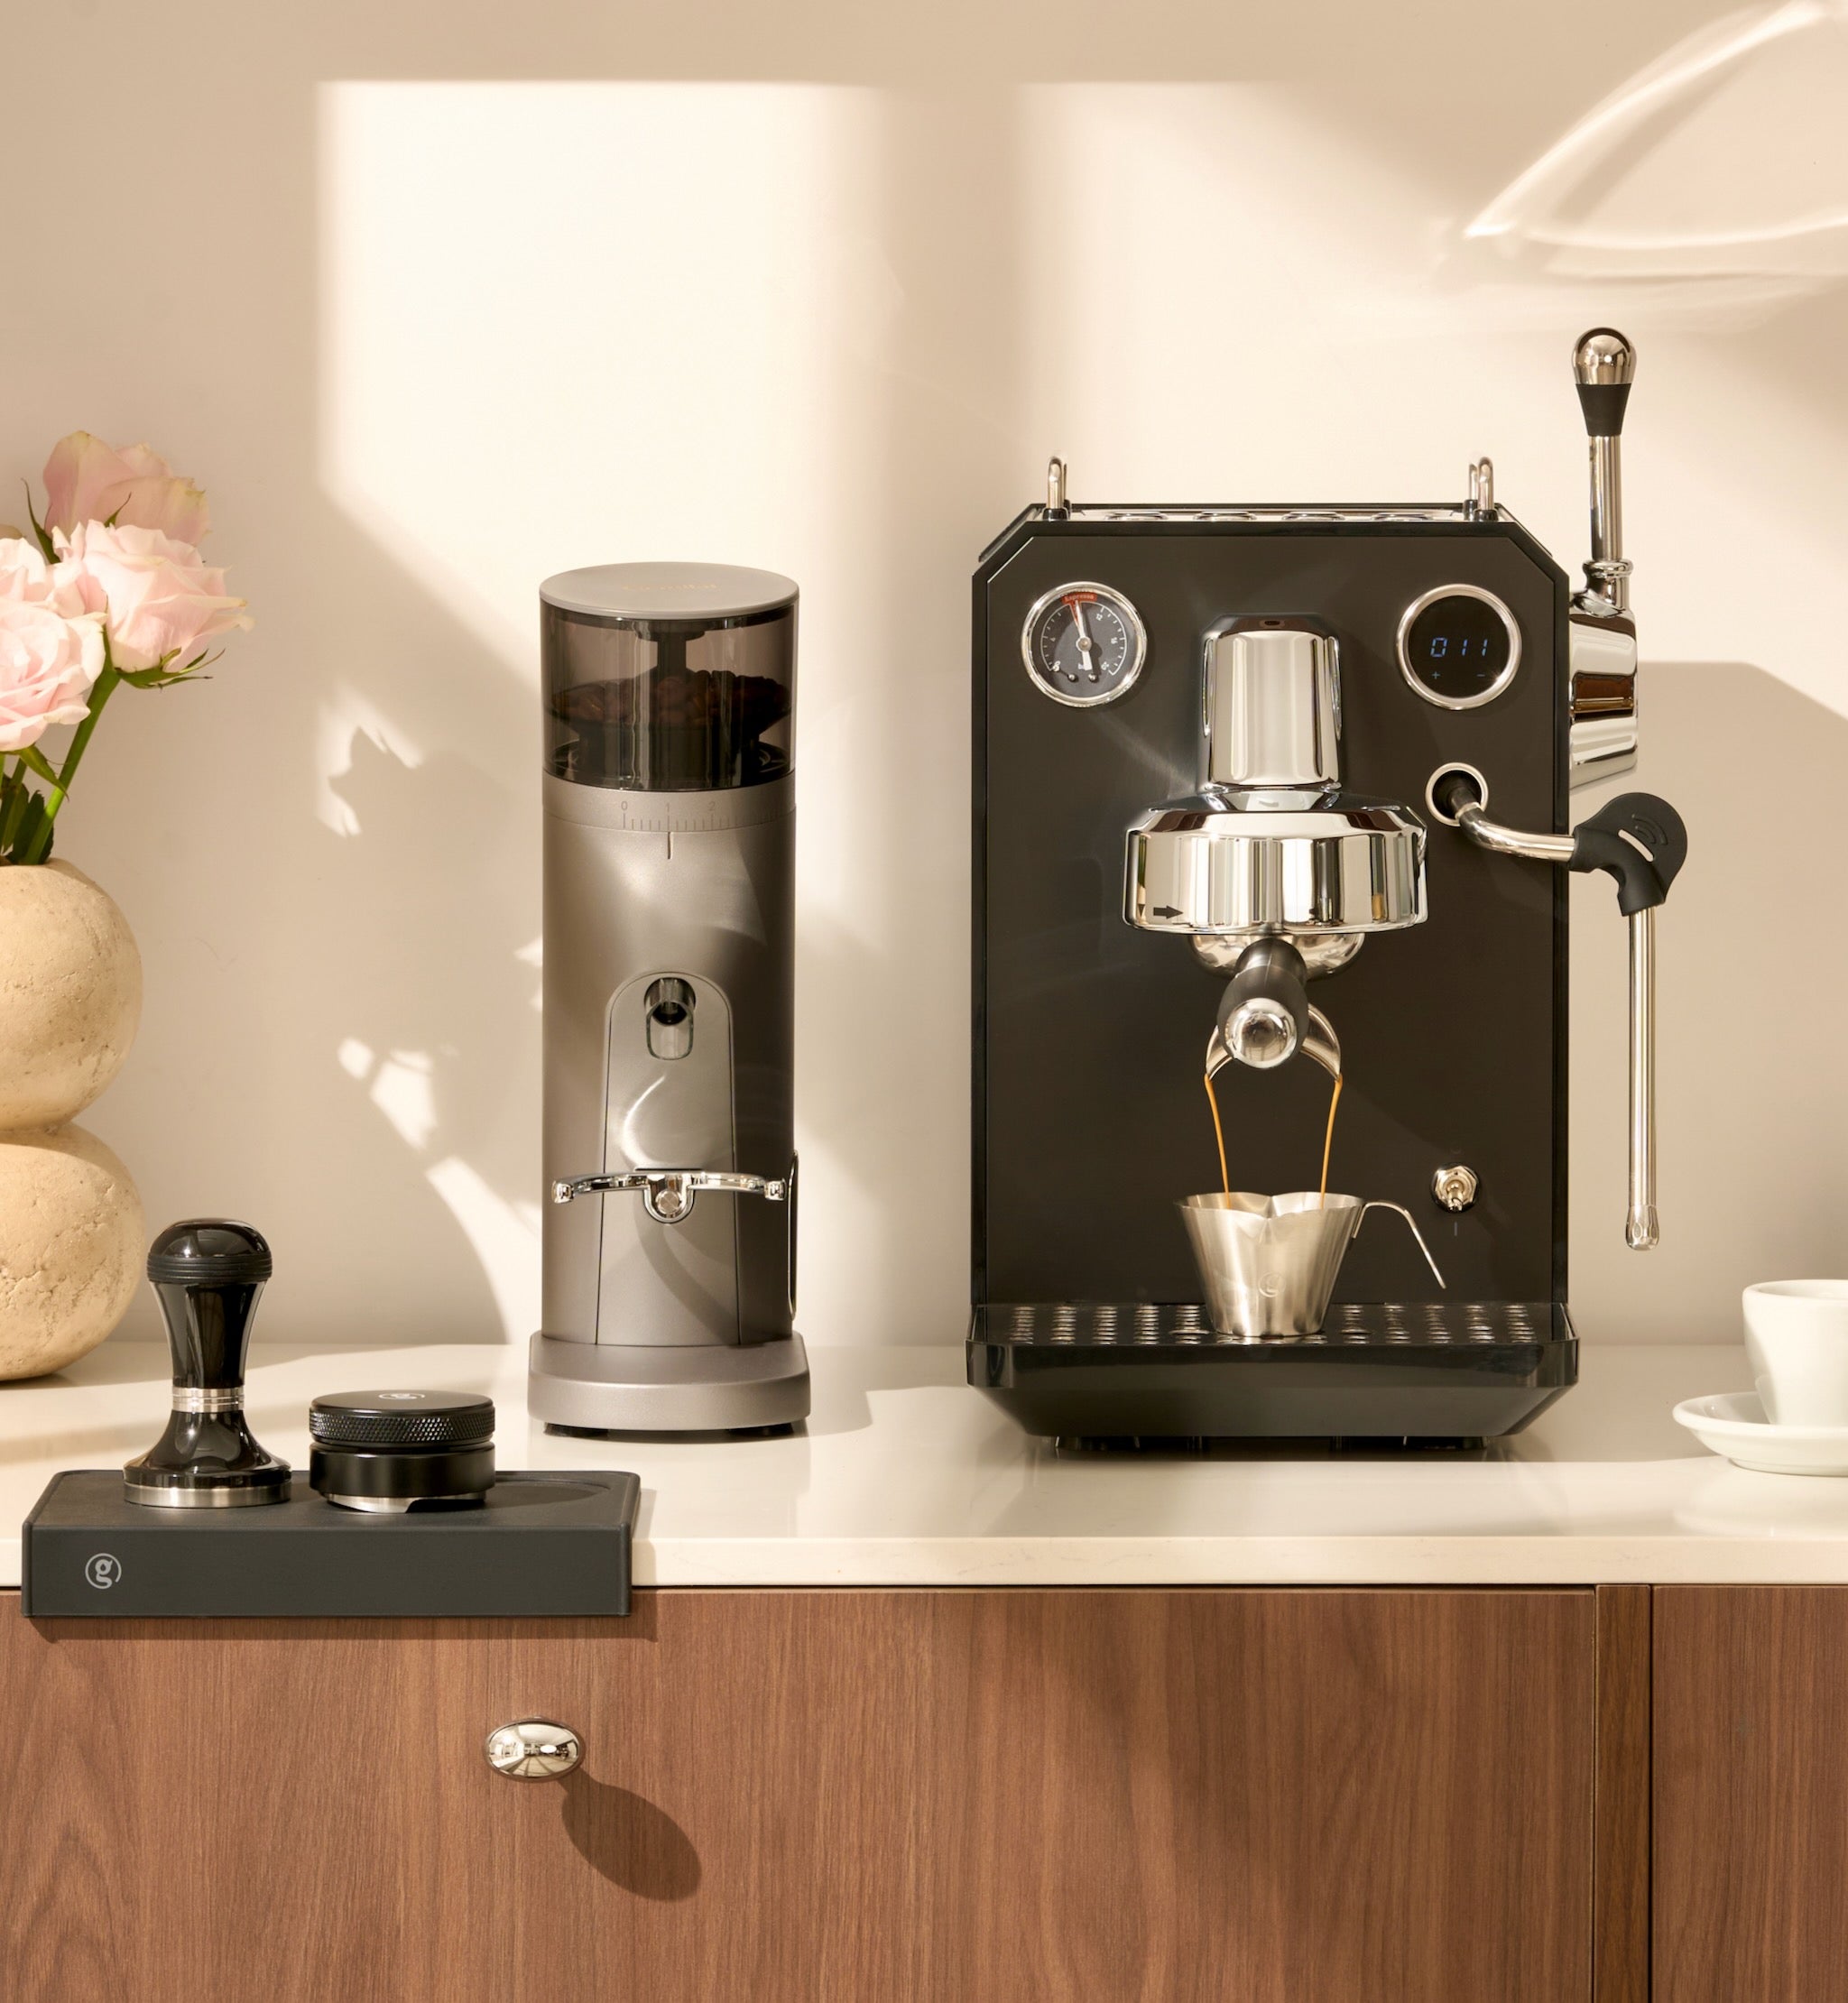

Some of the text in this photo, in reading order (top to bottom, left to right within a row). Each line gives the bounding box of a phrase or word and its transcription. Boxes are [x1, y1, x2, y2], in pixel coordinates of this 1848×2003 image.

[1430, 637, 1488, 658] 011
[621, 800, 628, 811] 0
[707, 800, 716, 811] 2
